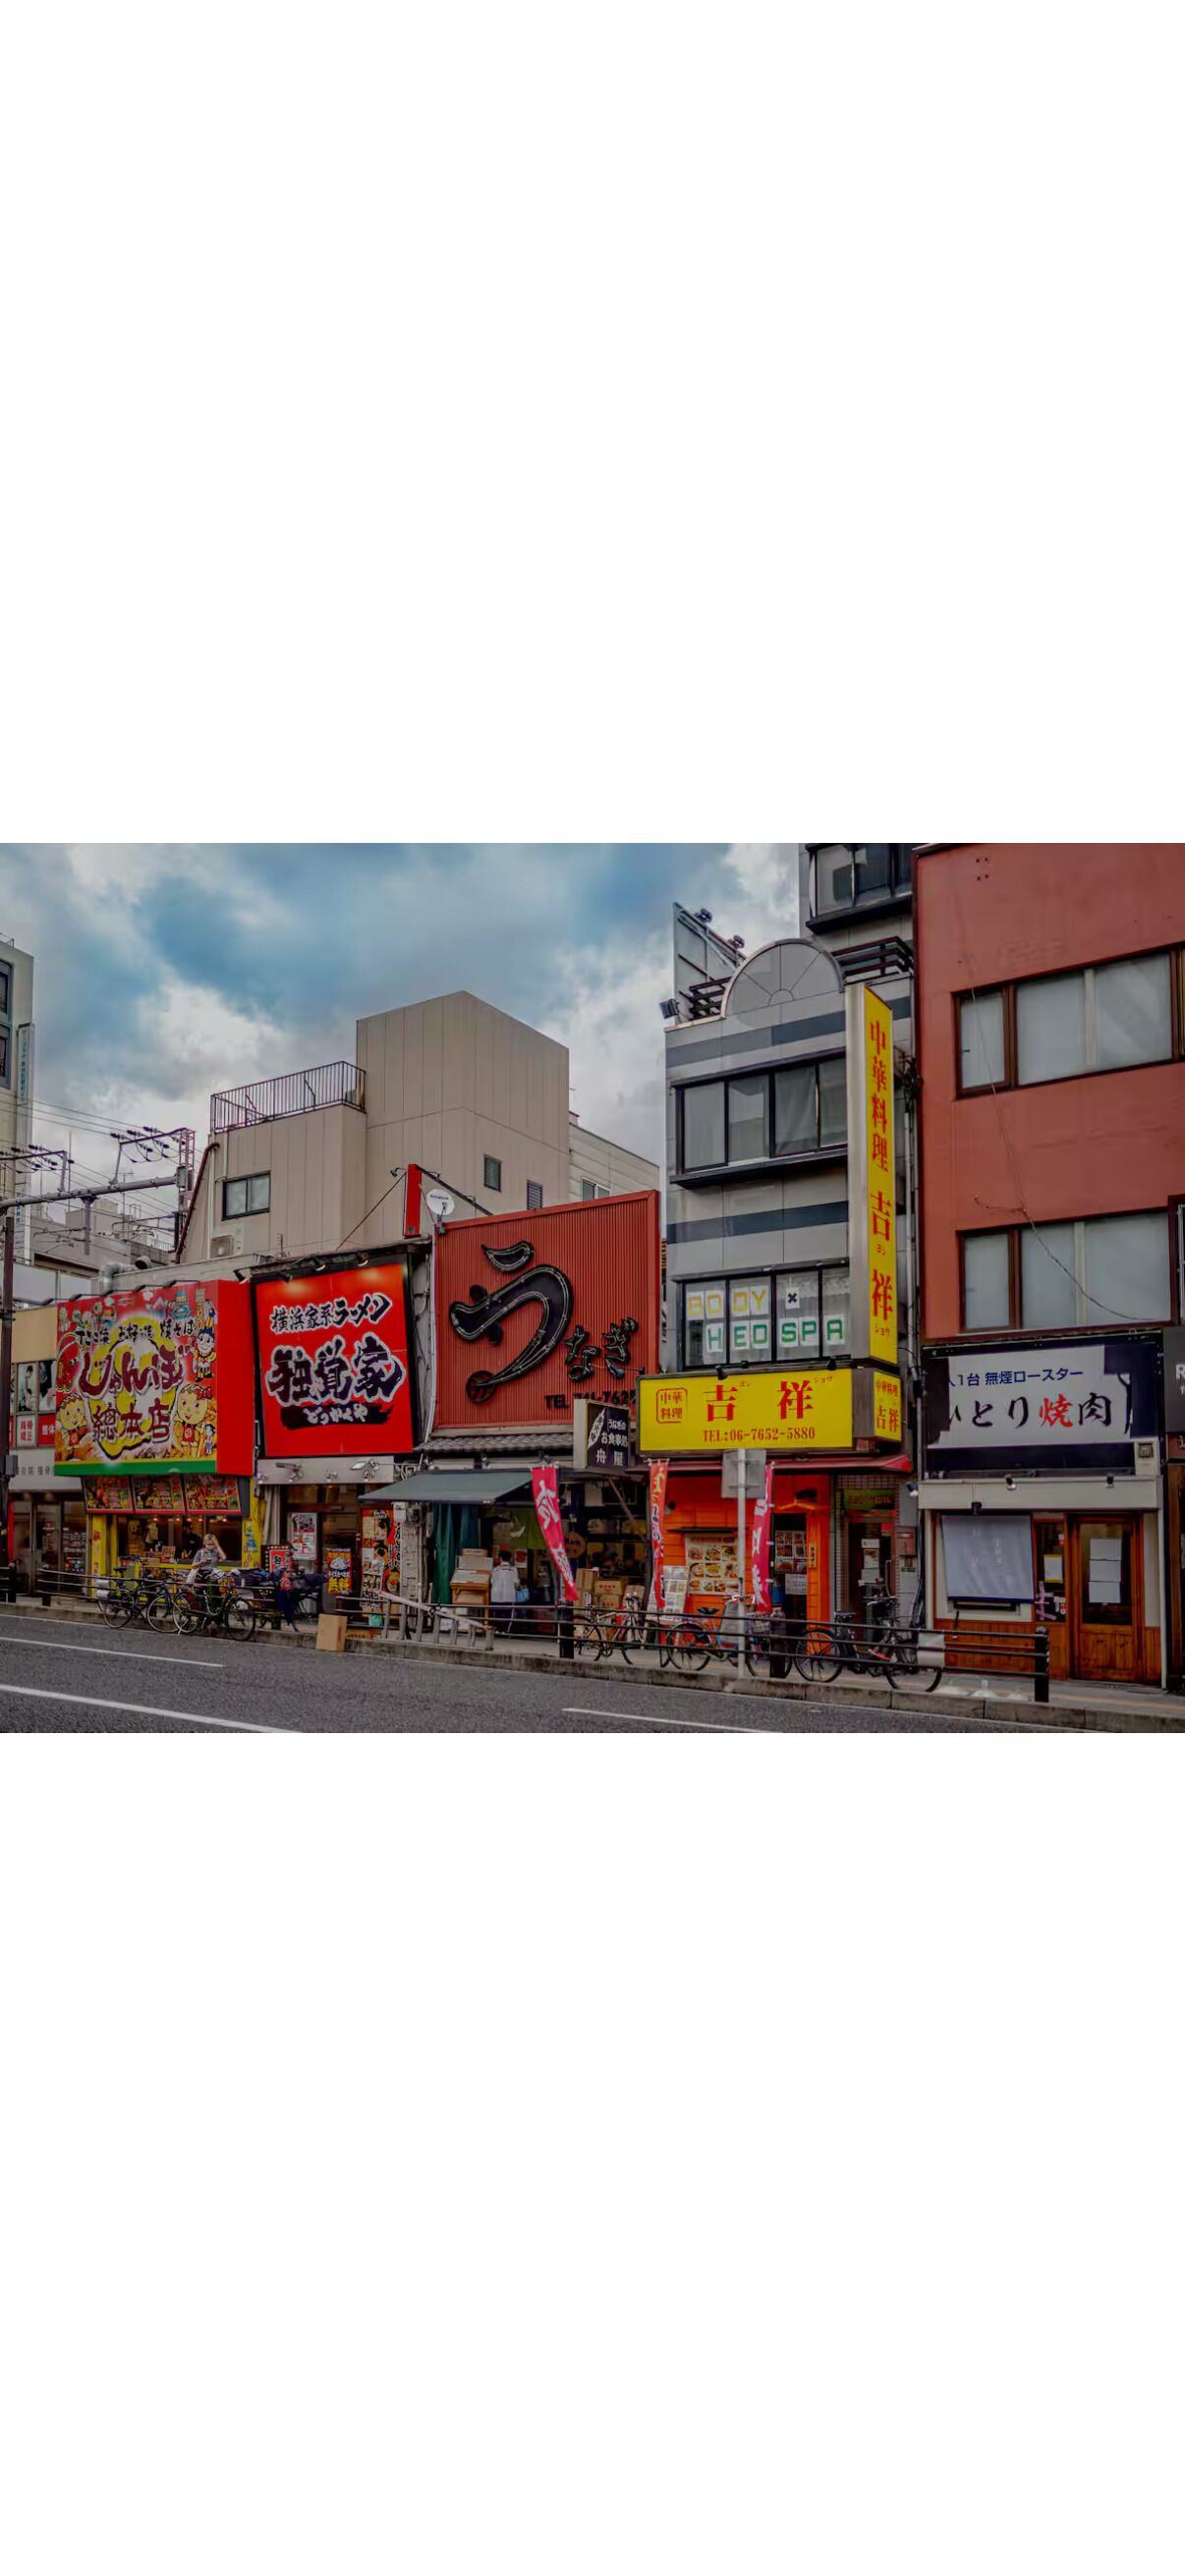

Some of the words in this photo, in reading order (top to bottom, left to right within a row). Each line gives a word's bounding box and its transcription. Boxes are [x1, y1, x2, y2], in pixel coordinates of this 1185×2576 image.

[871, 1021, 888, 1172] 中華料理
[271, 1293, 392, 1333] 横浜家系ラーメン
[688, 1289, 767, 1317] BODY
[449, 1241, 638, 1403] うなぎ
[781, 1318, 843, 1343] SPA
[985, 1368, 1084, 1386] 無煙ロースター
[544, 1394, 569, 1409] TEL
[660, 1391, 683, 1404] 中華
[660, 1407, 683, 1421] 料理
[704, 1427, 816, 1442] TEL:06-7652-5880
